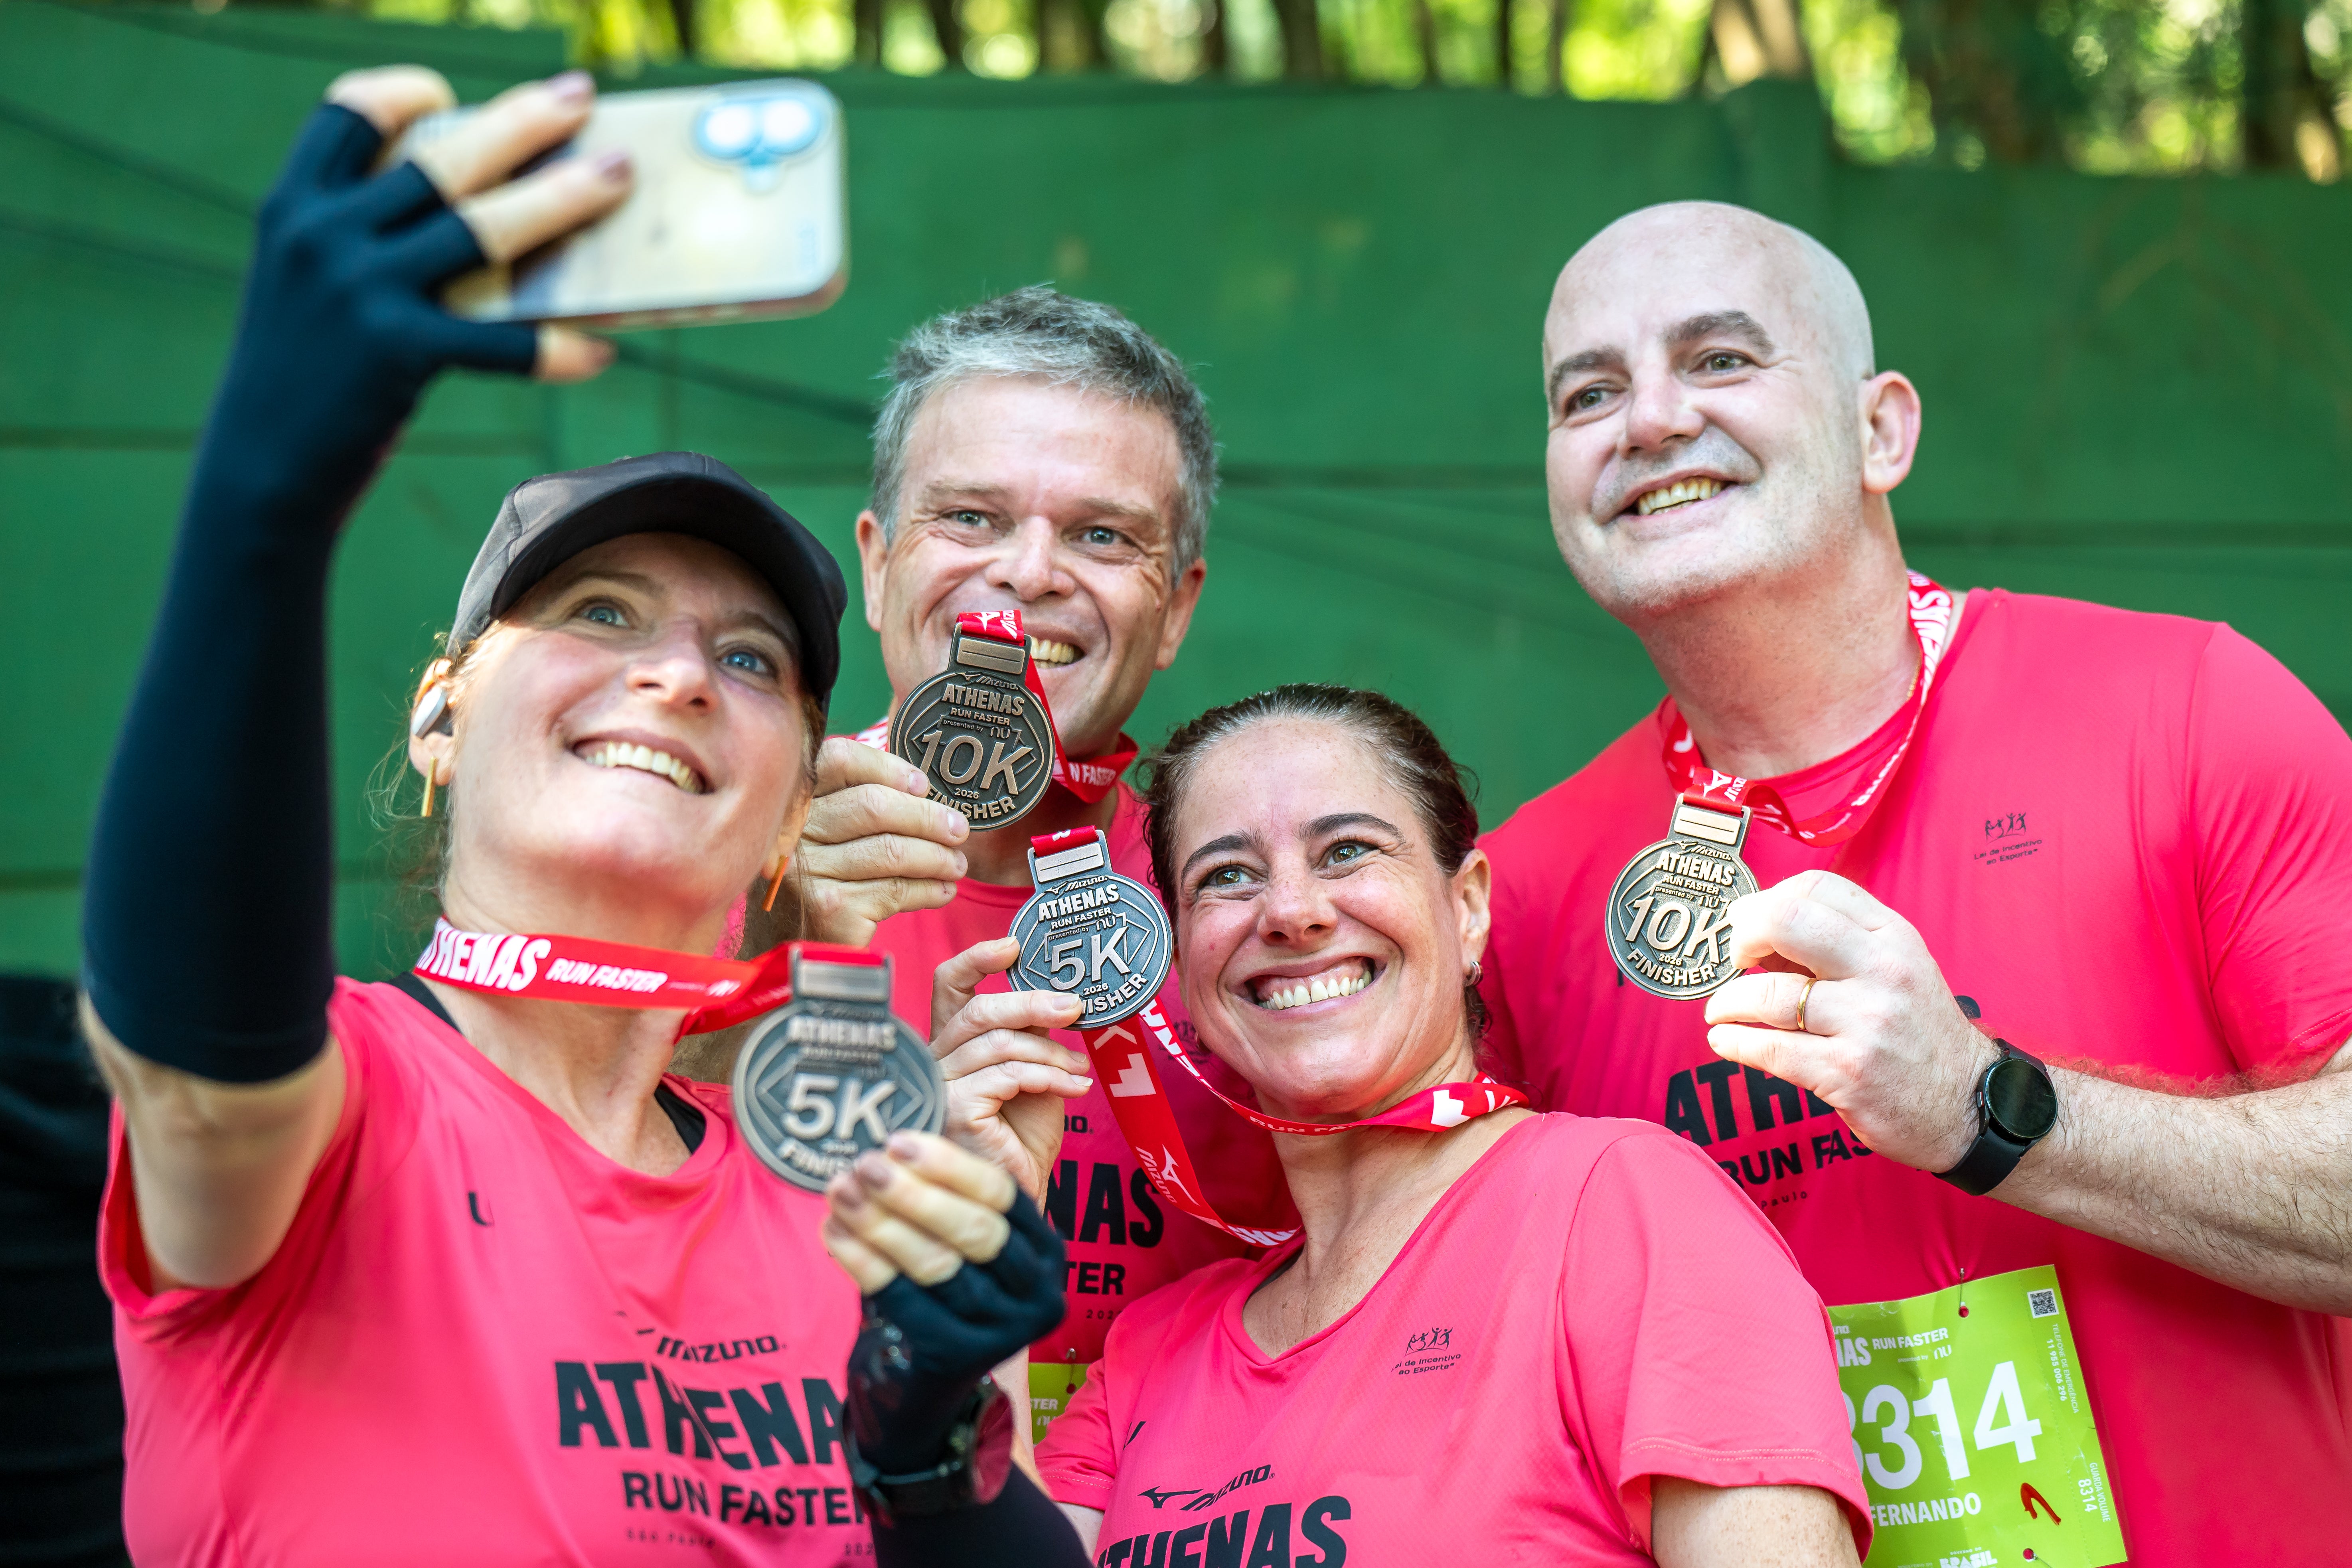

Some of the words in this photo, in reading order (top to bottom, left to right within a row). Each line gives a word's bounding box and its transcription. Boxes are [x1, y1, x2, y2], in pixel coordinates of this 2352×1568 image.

[942, 683, 1024, 716] ATHENAS
[943, 720, 974, 729] presented
[950, 707, 972, 719] RUN
[974, 712, 1010, 726] FASTER
[918, 729, 1033, 795] 10K
[954, 788, 979, 799] 2026
[2002, 839, 2042, 852] Incentivo
[1656, 851, 1736, 886] ATHENAS
[1065, 875, 1107, 891] MIZUNO
[1655, 886, 1685, 897] presented
[1663, 875, 1684, 888] RUN
[1684, 879, 1720, 895] FASTER
[1039, 884, 1120, 921] ATHENAS
[1051, 915, 1072, 929] RUN
[1074, 907, 1112, 923] FASTER
[1049, 928, 1080, 941] presented
[1625, 897, 1733, 964] 10K
[1049, 926, 1131, 990] 5K
[1627, 948, 1716, 986] FINISHER
[1658, 954, 1683, 966] 2026
[544, 957, 592, 982] RUN
[589, 965, 668, 993] FASTER
[1083, 983, 1108, 995] 2026
[782, 1072, 898, 1144] 5K
[1250, 1116, 1305, 1132] RUN
[1136, 1146, 1177, 1204] MIZUNO
[1872, 1337, 1896, 1350] RUN
[1897, 1327, 1949, 1348] FASTER
[2047, 1339, 2054, 1348] 11
[2052, 1323, 2065, 1357] TELEFONE
[1419, 1354, 1461, 1365] Incentivo
[2050, 1351, 2059, 1367] 955
[2061, 1359, 2068, 1368] DE
[2054, 1368, 2063, 1384] 006
[2058, 1385, 2067, 1401] 296
[2063, 1369, 2079, 1413] EMERGÊNCIA
[622, 1470, 711, 1517] RUN
[1180, 1463, 1270, 1511] MIZUNO
[2078, 1478, 2097, 1512] 8314
[2089, 1462, 2111, 1522] GUARDA-VOLUME
